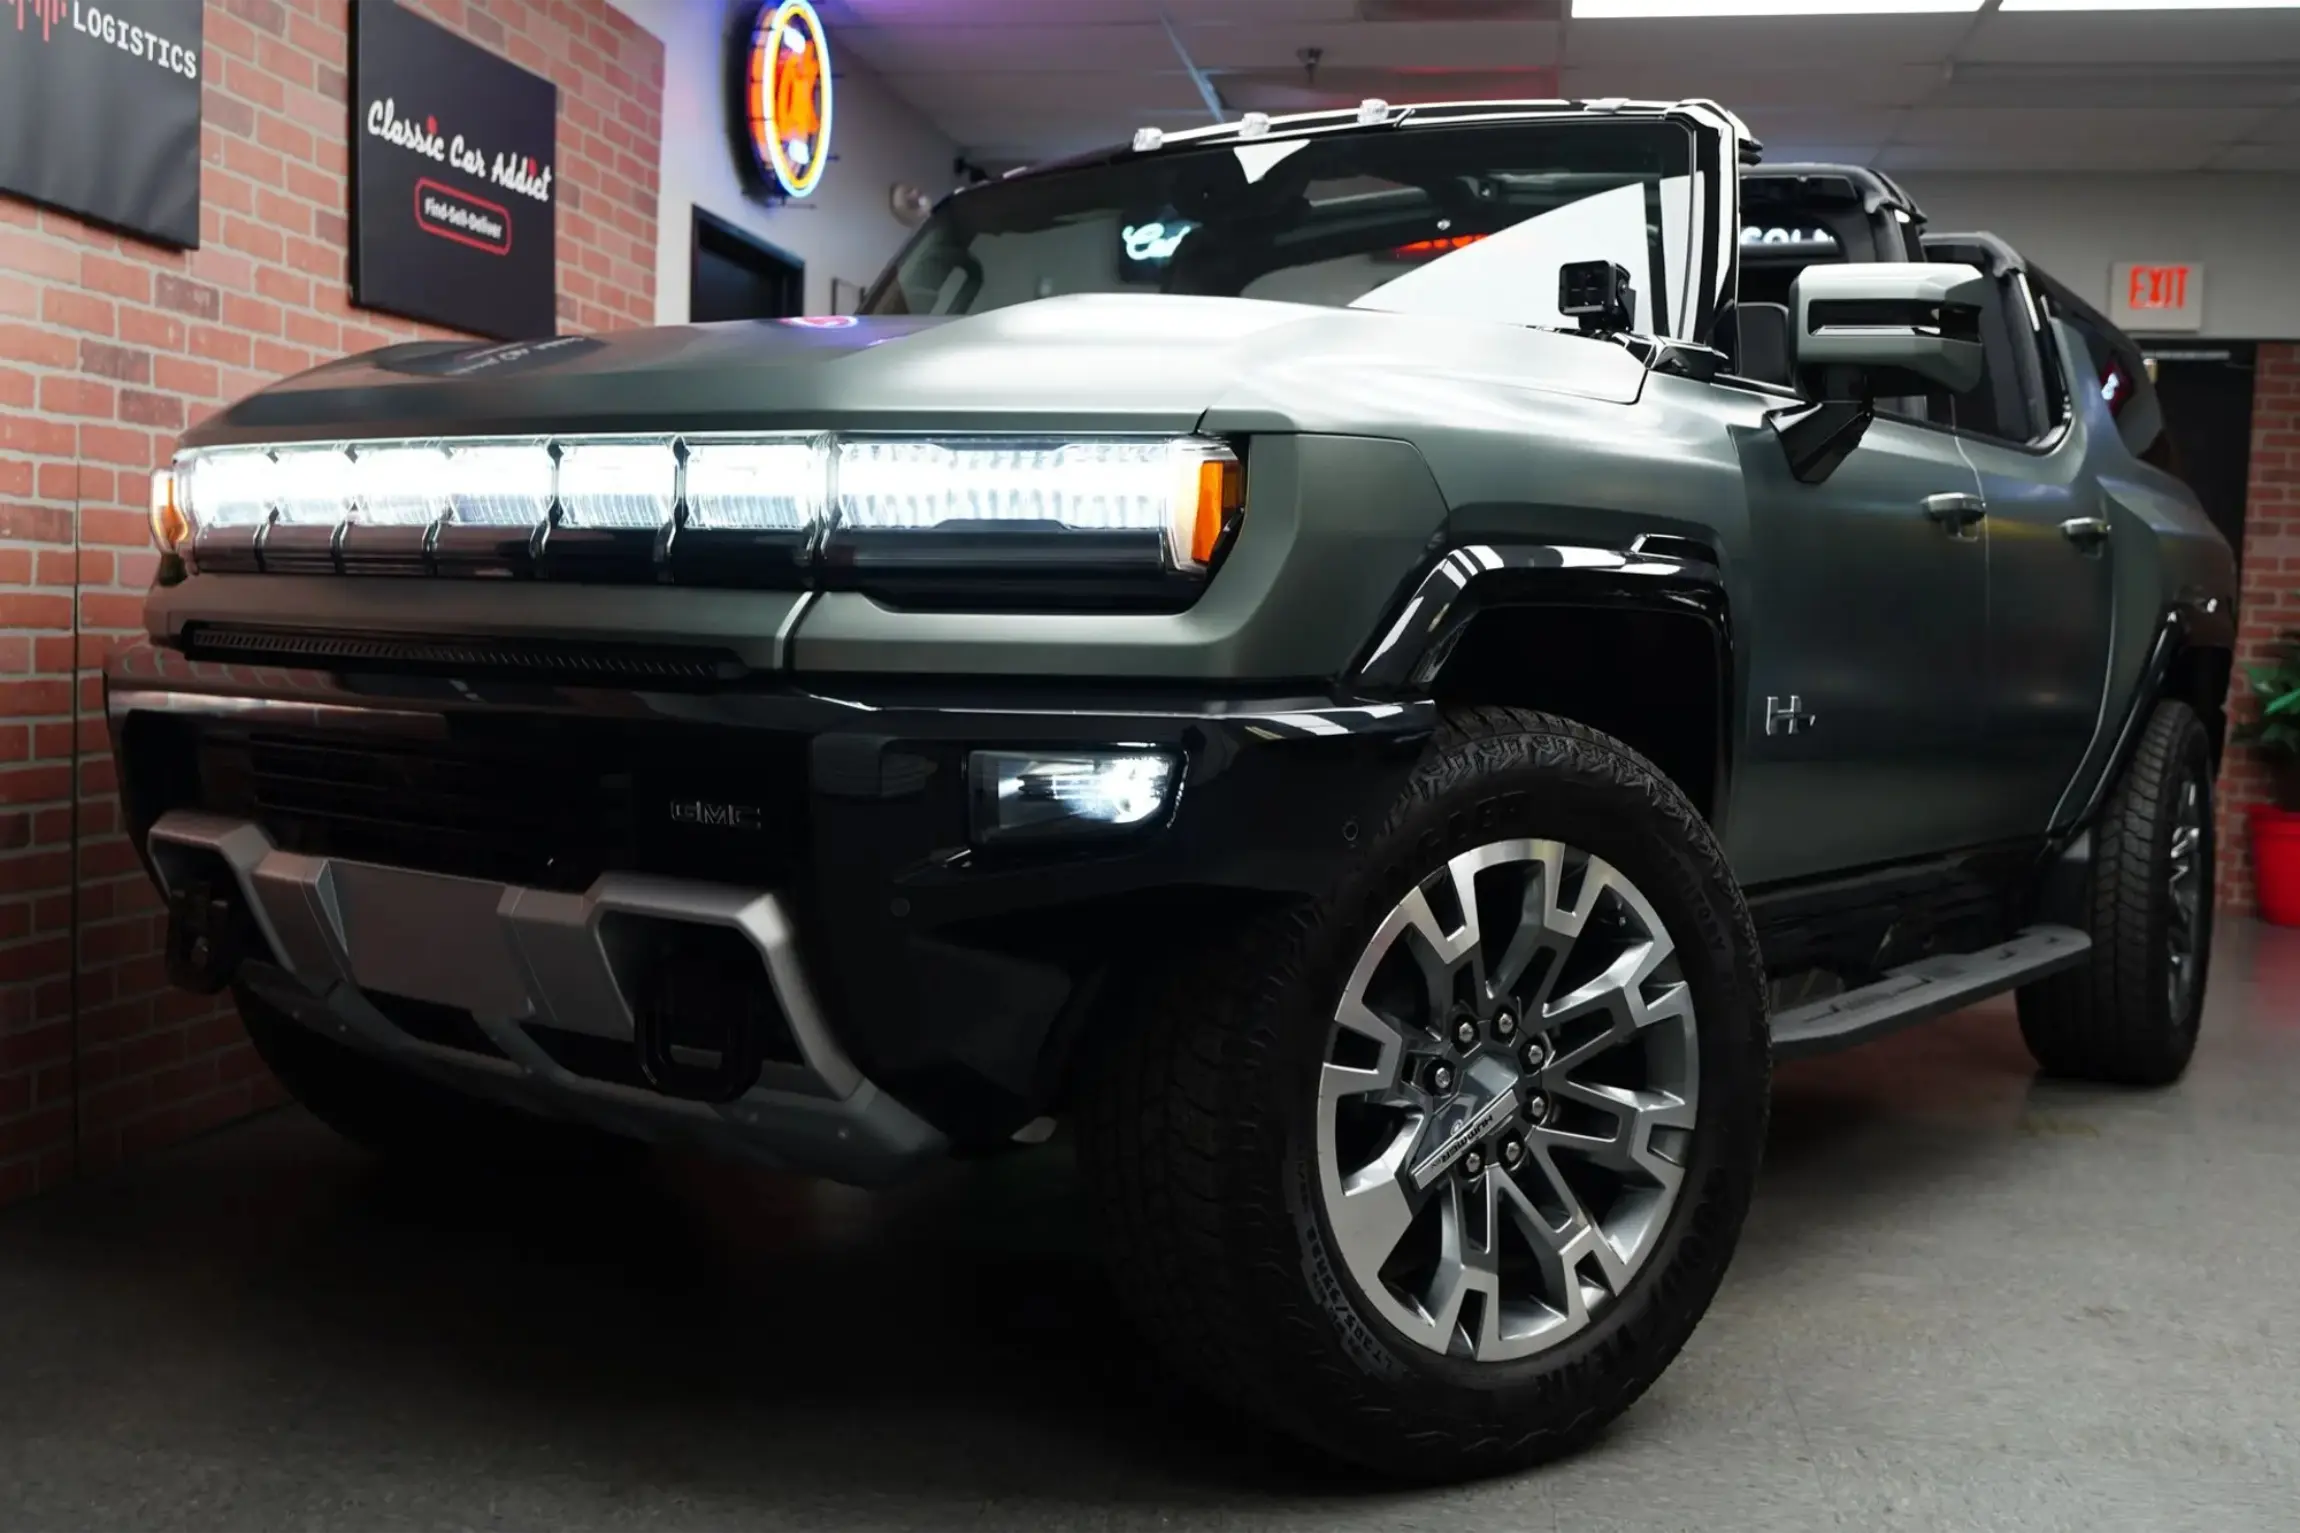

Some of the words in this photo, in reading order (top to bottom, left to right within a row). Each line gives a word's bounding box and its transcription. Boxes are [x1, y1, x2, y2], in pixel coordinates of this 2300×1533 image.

[73, 0, 196, 79] LOGISTICS
[367, 97, 445, 162] Classic
[450, 134, 486, 178] Car
[490, 151, 552, 202] Addict
[2129, 264, 2189, 310] EXIT
[670, 800, 762, 829] GMC
[1441, 1114, 1494, 1163] HUMMER
